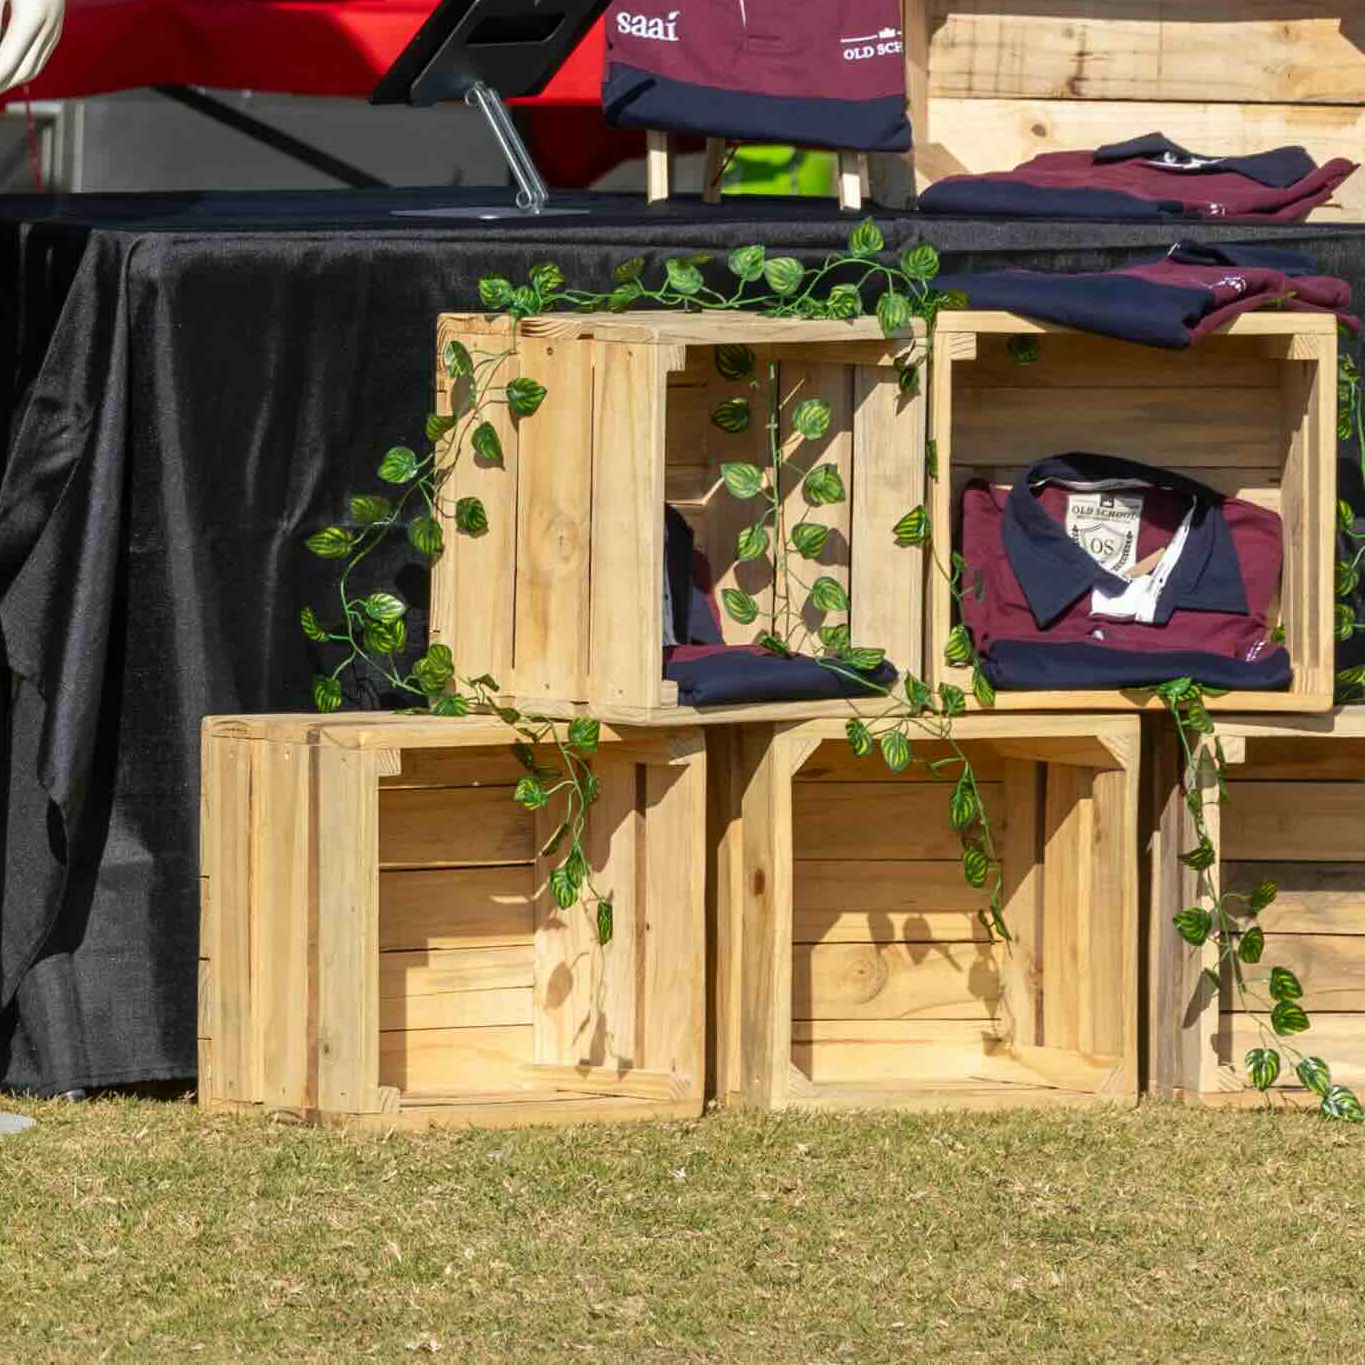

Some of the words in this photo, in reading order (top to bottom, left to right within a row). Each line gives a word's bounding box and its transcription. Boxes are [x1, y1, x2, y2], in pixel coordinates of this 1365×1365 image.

[616, 10, 680, 42] saai
[843, 46, 874, 60] OLD
[876, 41, 901, 56] SCH
[1072, 505, 1094, 516] OLD
[1096, 508, 1139, 520] SCHOOL
[1091, 537, 1115, 555] OS
